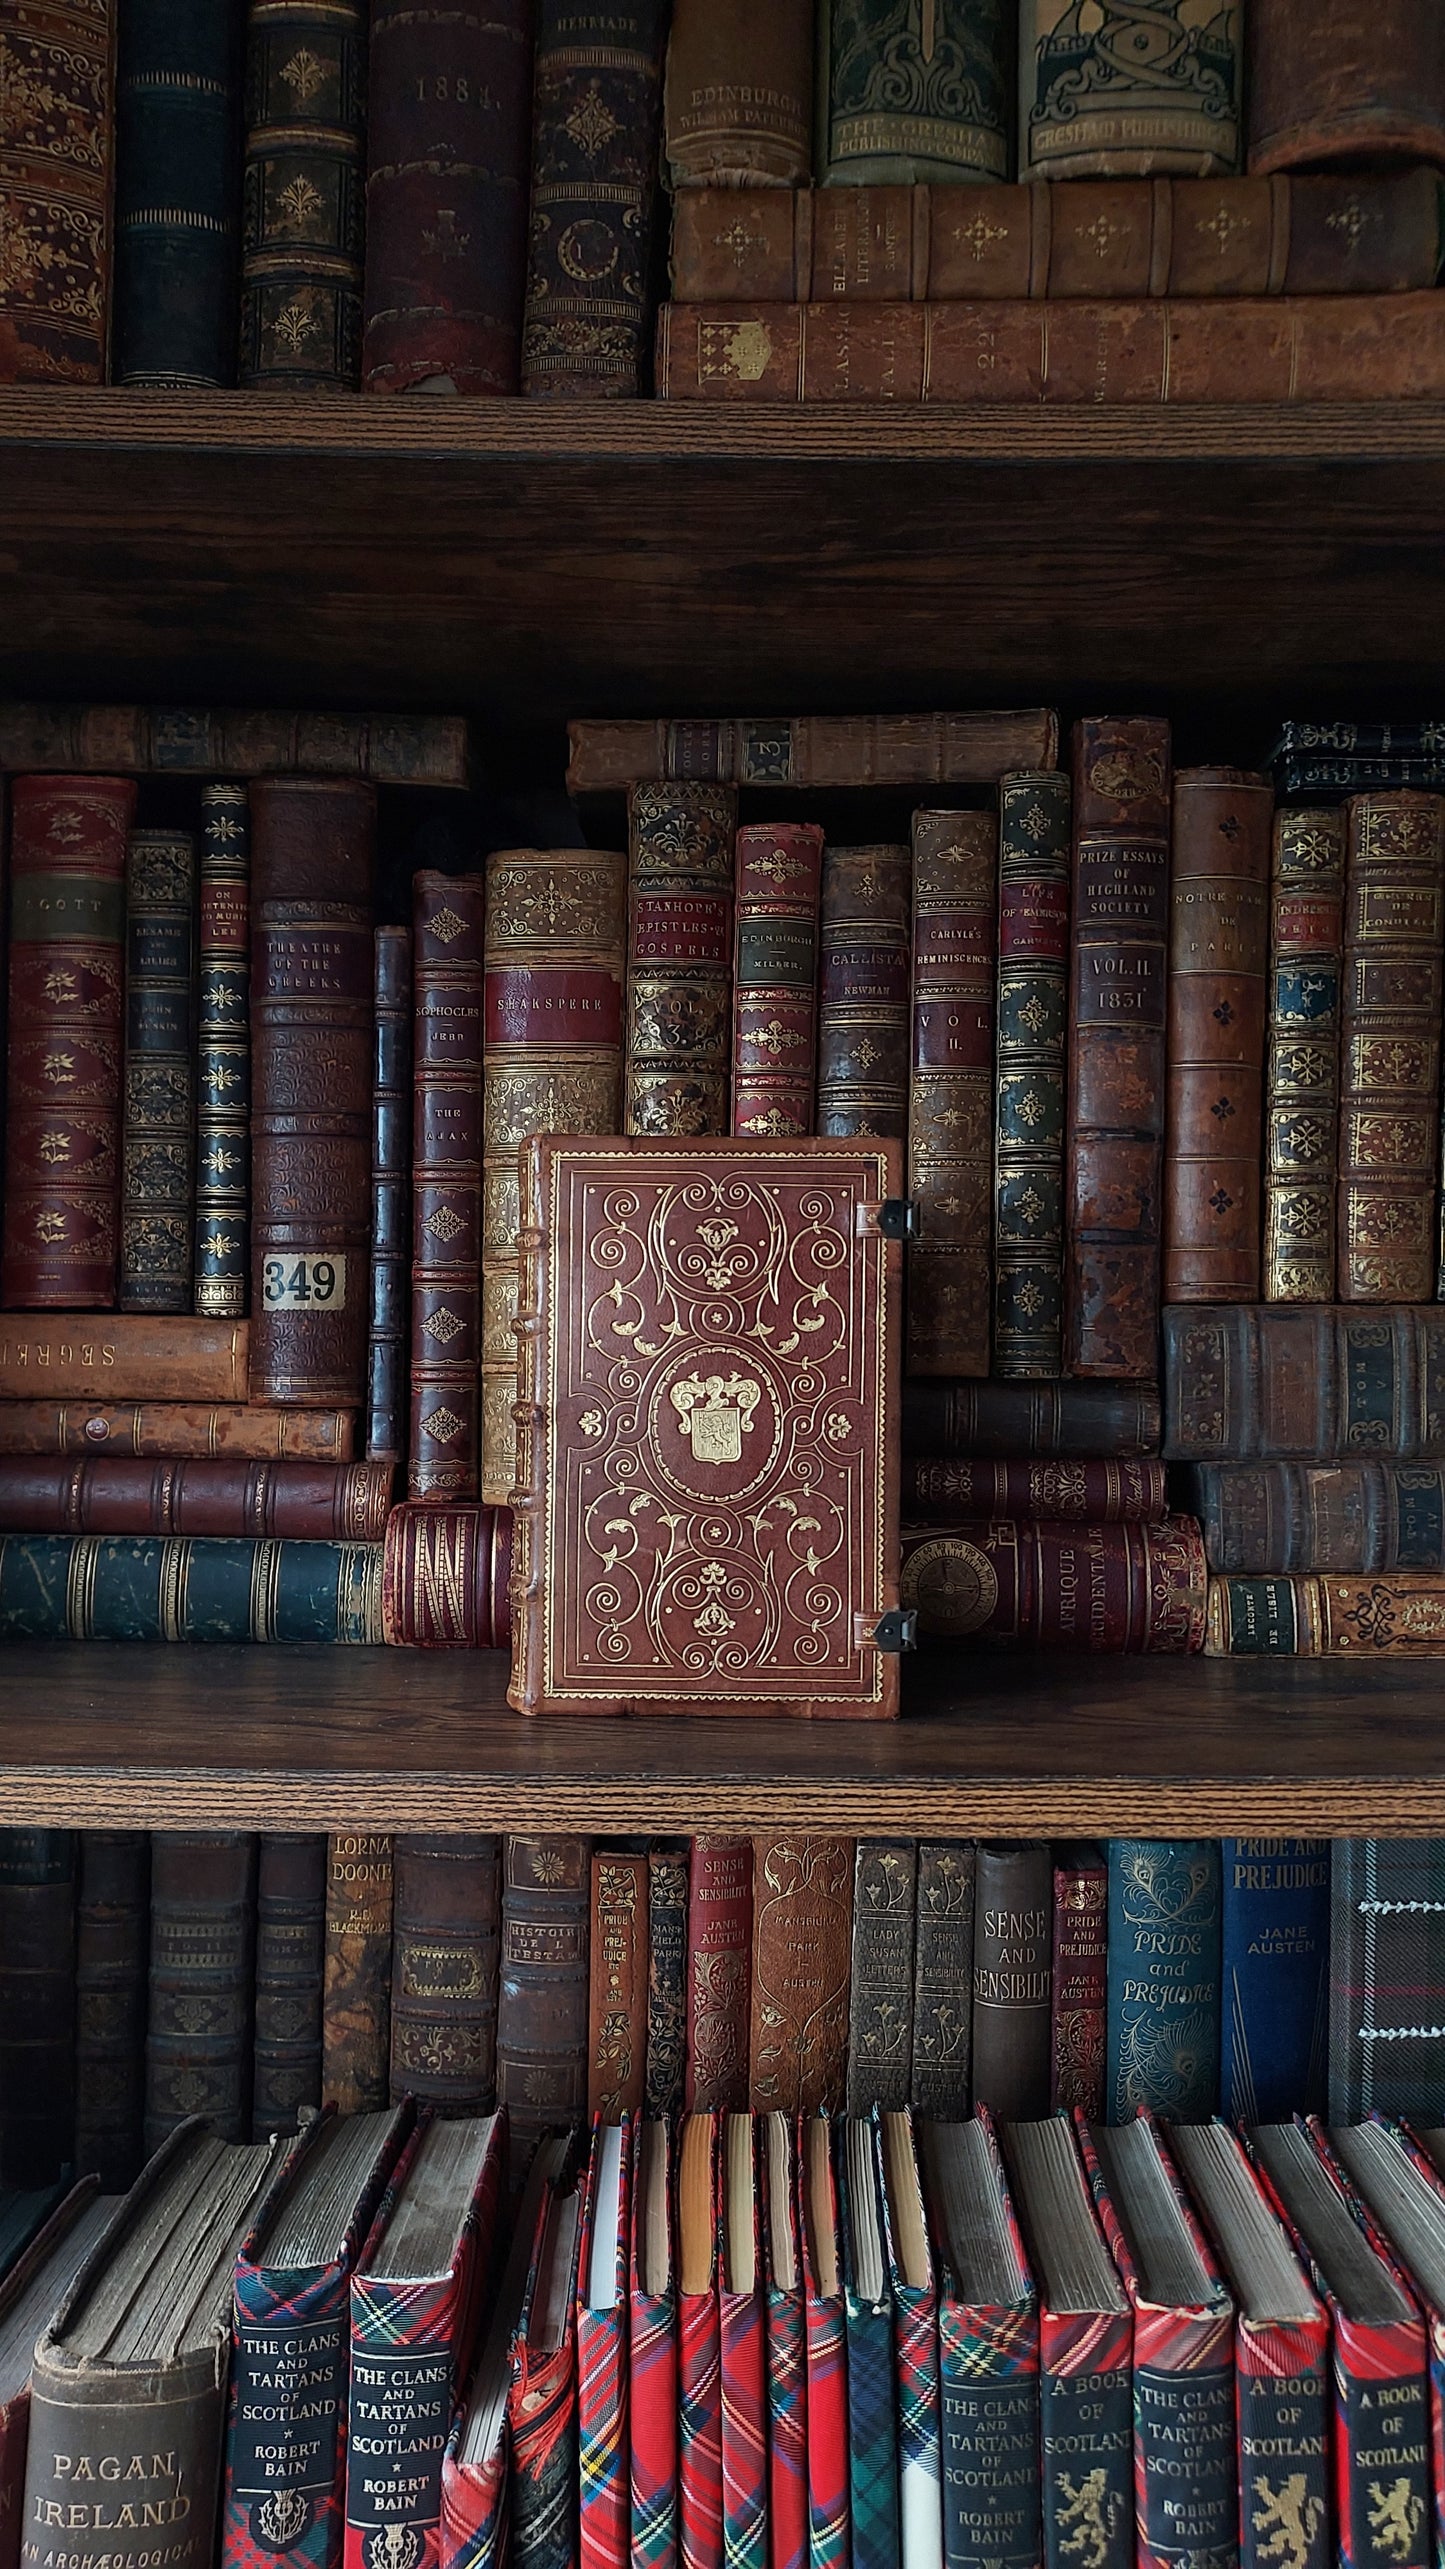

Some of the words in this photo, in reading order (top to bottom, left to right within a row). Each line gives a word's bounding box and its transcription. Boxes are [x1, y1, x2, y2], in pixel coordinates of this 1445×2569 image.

[557, 16, 638, 33] HENRIADE
[838, 118, 884, 139] THE
[839, 135, 931, 154] PUBLISHING
[978, 332, 995, 369] 22
[1080, 852, 1115, 864] PRIZE
[1123, 851, 1164, 864] ESSAYS
[1114, 868, 1130, 879] OF
[215, 891, 231, 899] ON
[1087, 884, 1156, 897] HIGHLAND
[1002, 908, 1016, 918] OF
[1090, 902, 1152, 914] SOCIETY
[741, 935, 813, 946] EDINBURGH
[930, 927, 982, 940] CARLYLE'S
[267, 943, 342, 955] THEATRE
[637, 943, 720, 957] GOSPELS
[274, 959, 293, 970] OF
[301, 959, 331, 970] THE
[831, 955, 904, 966] CALLISTA
[268, 977, 341, 989] GREEKS
[843, 985, 890, 995] NEWMAN
[497, 998, 602, 1011] SHAKSPERE
[1099, 992, 1142, 1009] 1831
[415, 1007, 479, 1017] SOPHOCLES
[435, 1109, 461, 1118] THE
[427, 1132, 468, 1141] AJAX
[265, 1260, 336, 1300] 349
[1356, 1361, 1367, 1409] TOM
[1059, 1549, 1080, 1634] AFRIQUE
[1266, 1584, 1278, 1624] LISLE
[1246, 1593, 1255, 1638] LECONTE
[1270, 1627, 1278, 1645] DE
[334, 1836, 391, 1855] LORNA
[1236, 1838, 1290, 1858] PRIDE
[1294, 1838, 1329, 1857] AND
[704, 1857, 744, 1873] SENSE
[712, 1875, 736, 1886] AND
[1233, 1861, 1328, 1889] PREJUDICE
[698, 1884, 748, 1901] SENSIBILITY
[329, 1921, 391, 1935] BLACKMORE
[604, 1915, 628, 1925] PRIDE
[707, 1919, 737, 1931] JANE
[984, 1909, 1047, 1941] SENSE
[1066, 1916, 1102, 1928] PRIDE
[652, 1936, 681, 1945] FIELD
[700, 1929, 745, 1945] AUSTEN
[873, 1929, 900, 1941] LADY
[1073, 1931, 1096, 1941] AND
[1258, 1926, 1308, 1940] JANE
[519, 1939, 538, 1948] DE
[1060, 1943, 1107, 1956] PREJUDICE
[1133, 1930, 1202, 1956] PRIDE
[1247, 1940, 1316, 1955] AUSTEN
[603, 1951, 627, 1961] UDICE
[870, 1947, 903, 1958] SUSAN
[998, 1947, 1036, 1963] AND
[864, 1964, 907, 1975] LETTERS
[1150, 1960, 1190, 1977] and
[974, 1967, 1051, 2001] SENSIBILIT
[1067, 1975, 1099, 1985] JANE
[1060, 1987, 1105, 2000] AUSTEN
[1122, 1979, 1216, 2013] PREJUDICE
[243, 2339, 280, 2356] THE
[284, 2332, 341, 2355] CLANS
[276, 2358, 309, 2370] AND
[248, 2366, 335, 2390] TARTANS
[354, 2365, 387, 2386] THE
[391, 2365, 448, 2386] CLANS
[1050, 2377, 1067, 2396] A
[1249, 2379, 1267, 2396] A
[280, 2392, 300, 2404] OF
[382, 2389, 415, 2401] AND
[1141, 2386, 1178, 2409] THE
[1183, 2388, 1231, 2409] CLAN
[1359, 2393, 1374, 2409] A
[1377, 2384, 1422, 2405] BOOK
[242, 2399, 337, 2422] SCOTLAND
[355, 2400, 442, 2420] TARTANS
[944, 2397, 979, 2418] THE
[984, 2398, 1031, 2418] CLAN
[1078, 2402, 1104, 2421] OF
[1176, 2410, 1208, 2424] AND
[1276, 2408, 1302, 2424] OF
[387, 2424, 407, 2435] OF
[975, 2420, 1008, 2433] AND
[1148, 2422, 1232, 2444] TARTANS
[1381, 2416, 1403, 2435] OF
[254, 2440, 321, 2460] ROBERT
[352, 2434, 446, 2455] SCOTLAND
[947, 2433, 1034, 2452] TARTANS
[1242, 2436, 1325, 2456] SCOTLAN
[1184, 2446, 1204, 2459] OF
[52, 2451, 176, 2481] PAGAN
[264, 2461, 309, 2477] BAIN
[981, 2455, 1002, 2468] OF
[363, 2475, 430, 2494] ROBERT
[373, 2494, 418, 2511] BAIN
[1162, 2499, 1226, 2517] ROBERT
[32, 2495, 191, 2530] IRELAND
[958, 2509, 1026, 2527] ROBERT
[1174, 2519, 1217, 2537] BAIN
[970, 2529, 1015, 2544] BAIN
[21, 2540, 40, 2560] AN
